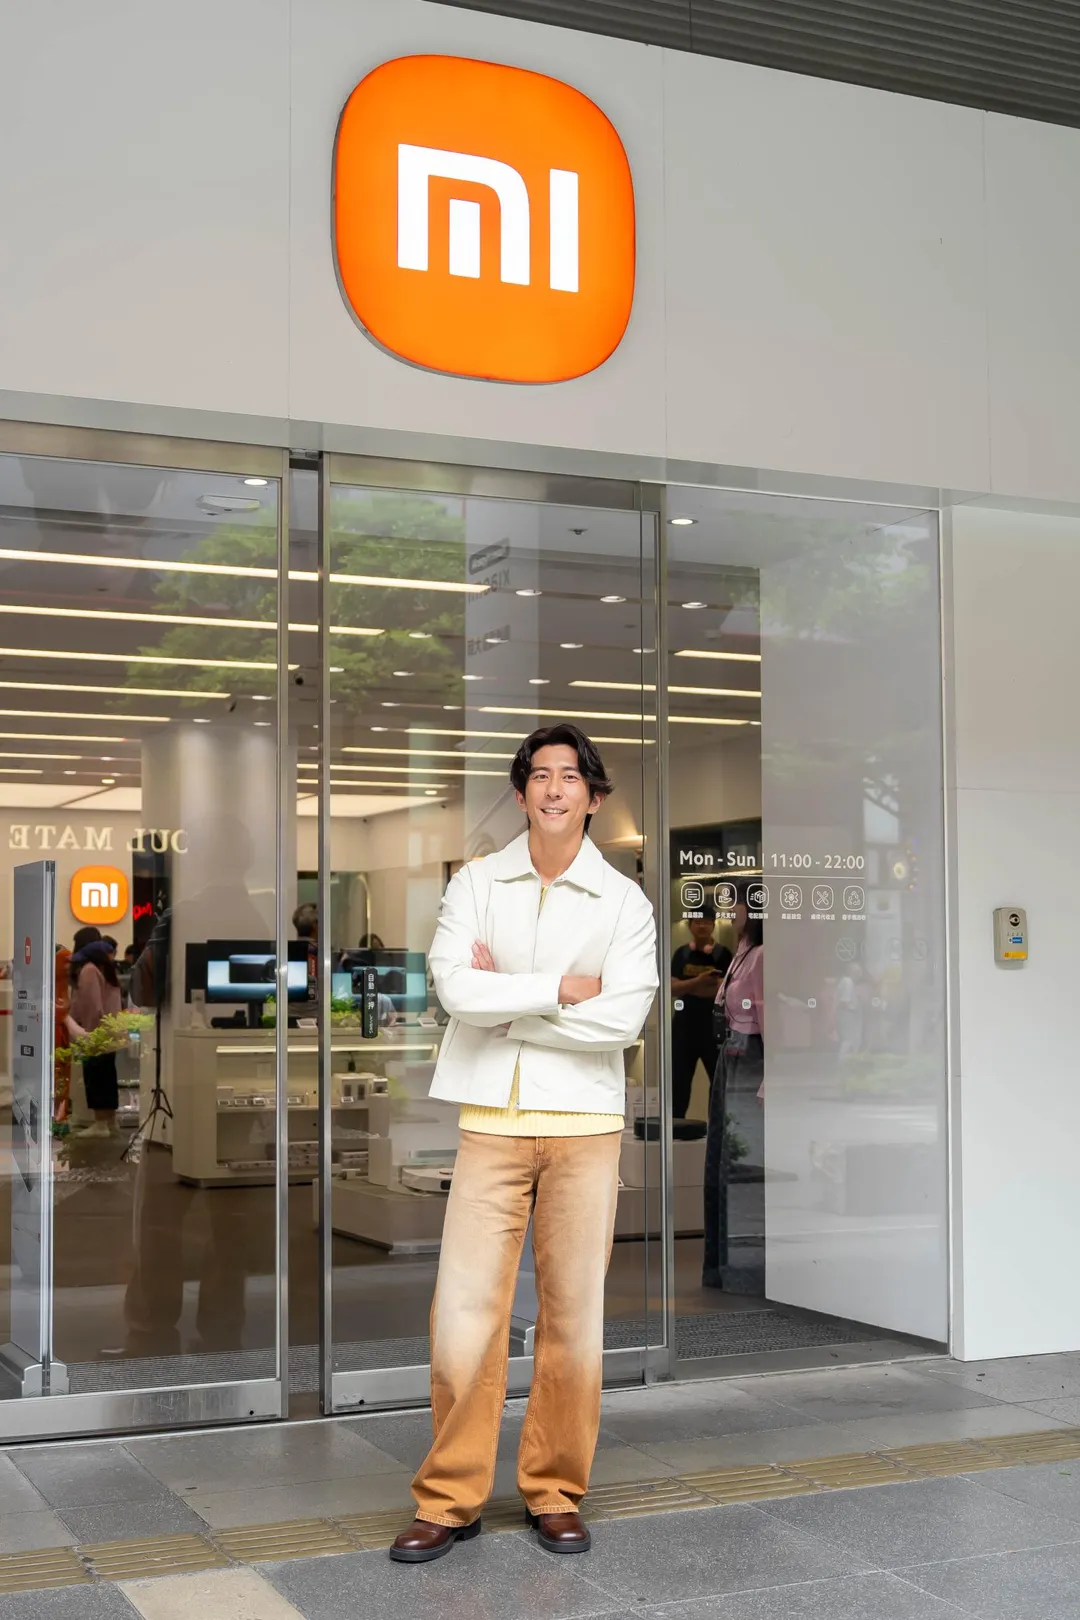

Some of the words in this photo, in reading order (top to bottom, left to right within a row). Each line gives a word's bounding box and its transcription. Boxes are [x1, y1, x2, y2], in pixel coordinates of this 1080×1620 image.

[679, 850, 714, 866] Mon
[726, 851, 756, 867] Sun
[770, 853, 812, 868] 11:00
[824, 854, 865, 869] 22:00
